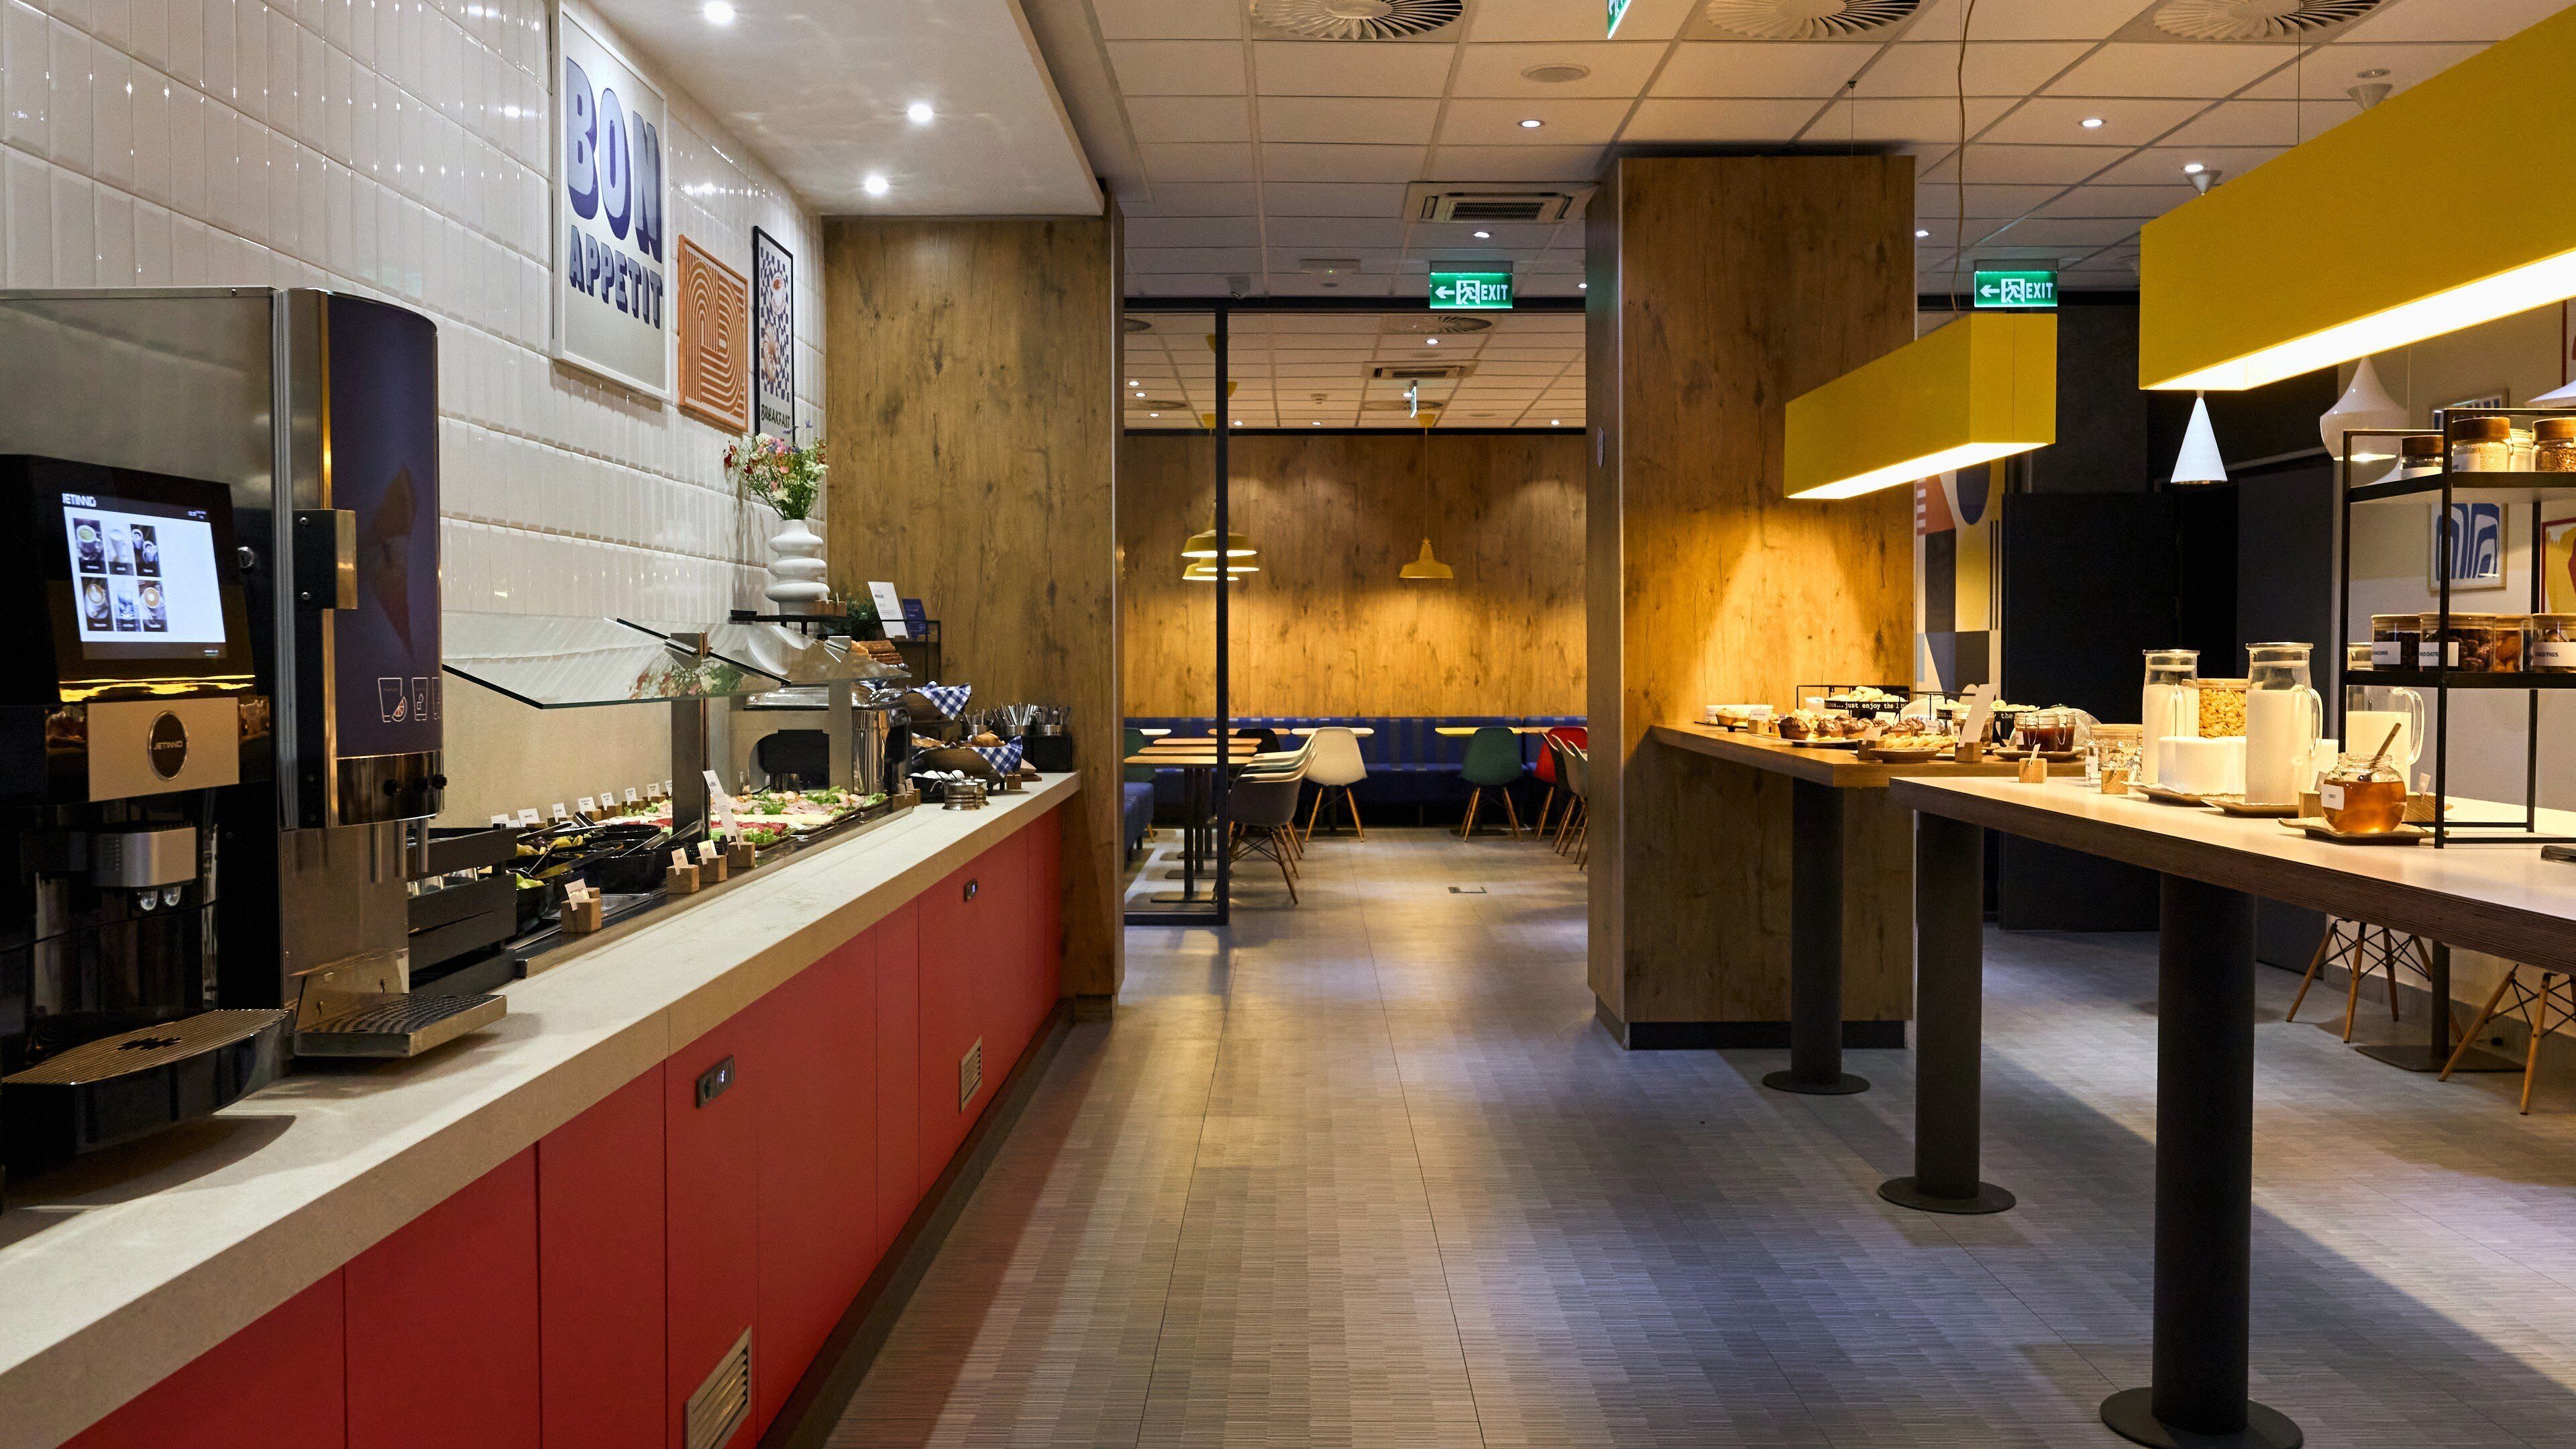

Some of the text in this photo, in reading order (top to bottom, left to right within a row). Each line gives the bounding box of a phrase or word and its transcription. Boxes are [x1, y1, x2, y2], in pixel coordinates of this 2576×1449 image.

[567, 56, 662, 264] BON
[569, 224, 663, 329] APPETIT
[1481, 284, 1508, 301] EXIT
[2026, 282, 2053, 299] EXIT
[761, 404, 790, 429] BREAKFAST
[1862, 702, 1881, 710] enjoy
